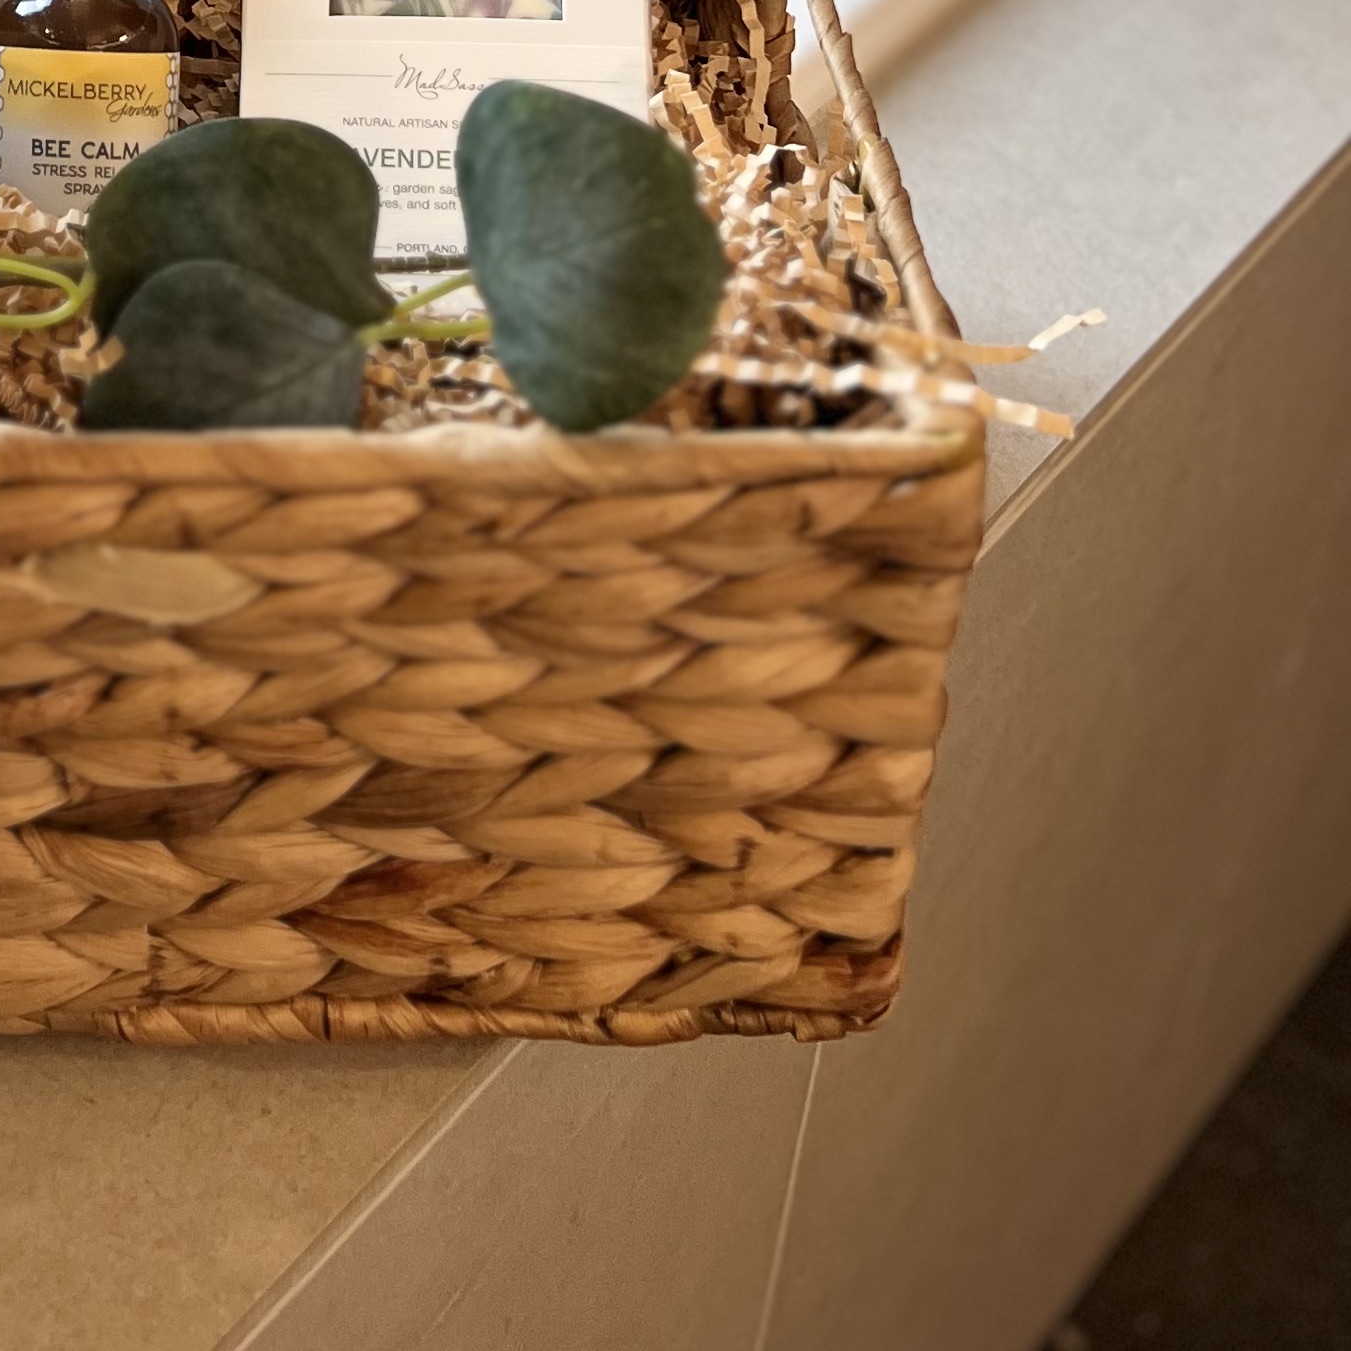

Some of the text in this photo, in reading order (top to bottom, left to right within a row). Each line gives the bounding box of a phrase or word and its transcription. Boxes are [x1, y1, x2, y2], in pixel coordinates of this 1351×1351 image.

[7, 78, 147, 101] MICKELBERRY
[342, 117, 396, 128] NATURAL
[398, 118, 449, 130] ARTISAN
[31, 138, 141, 160] BEE CALM
[362, 147, 454, 170] VENDE
[32, 163, 87, 178] STRESS
[392, 184, 436, 196] garden
[406, 200, 430, 210] and
[434, 200, 457, 211] soft
